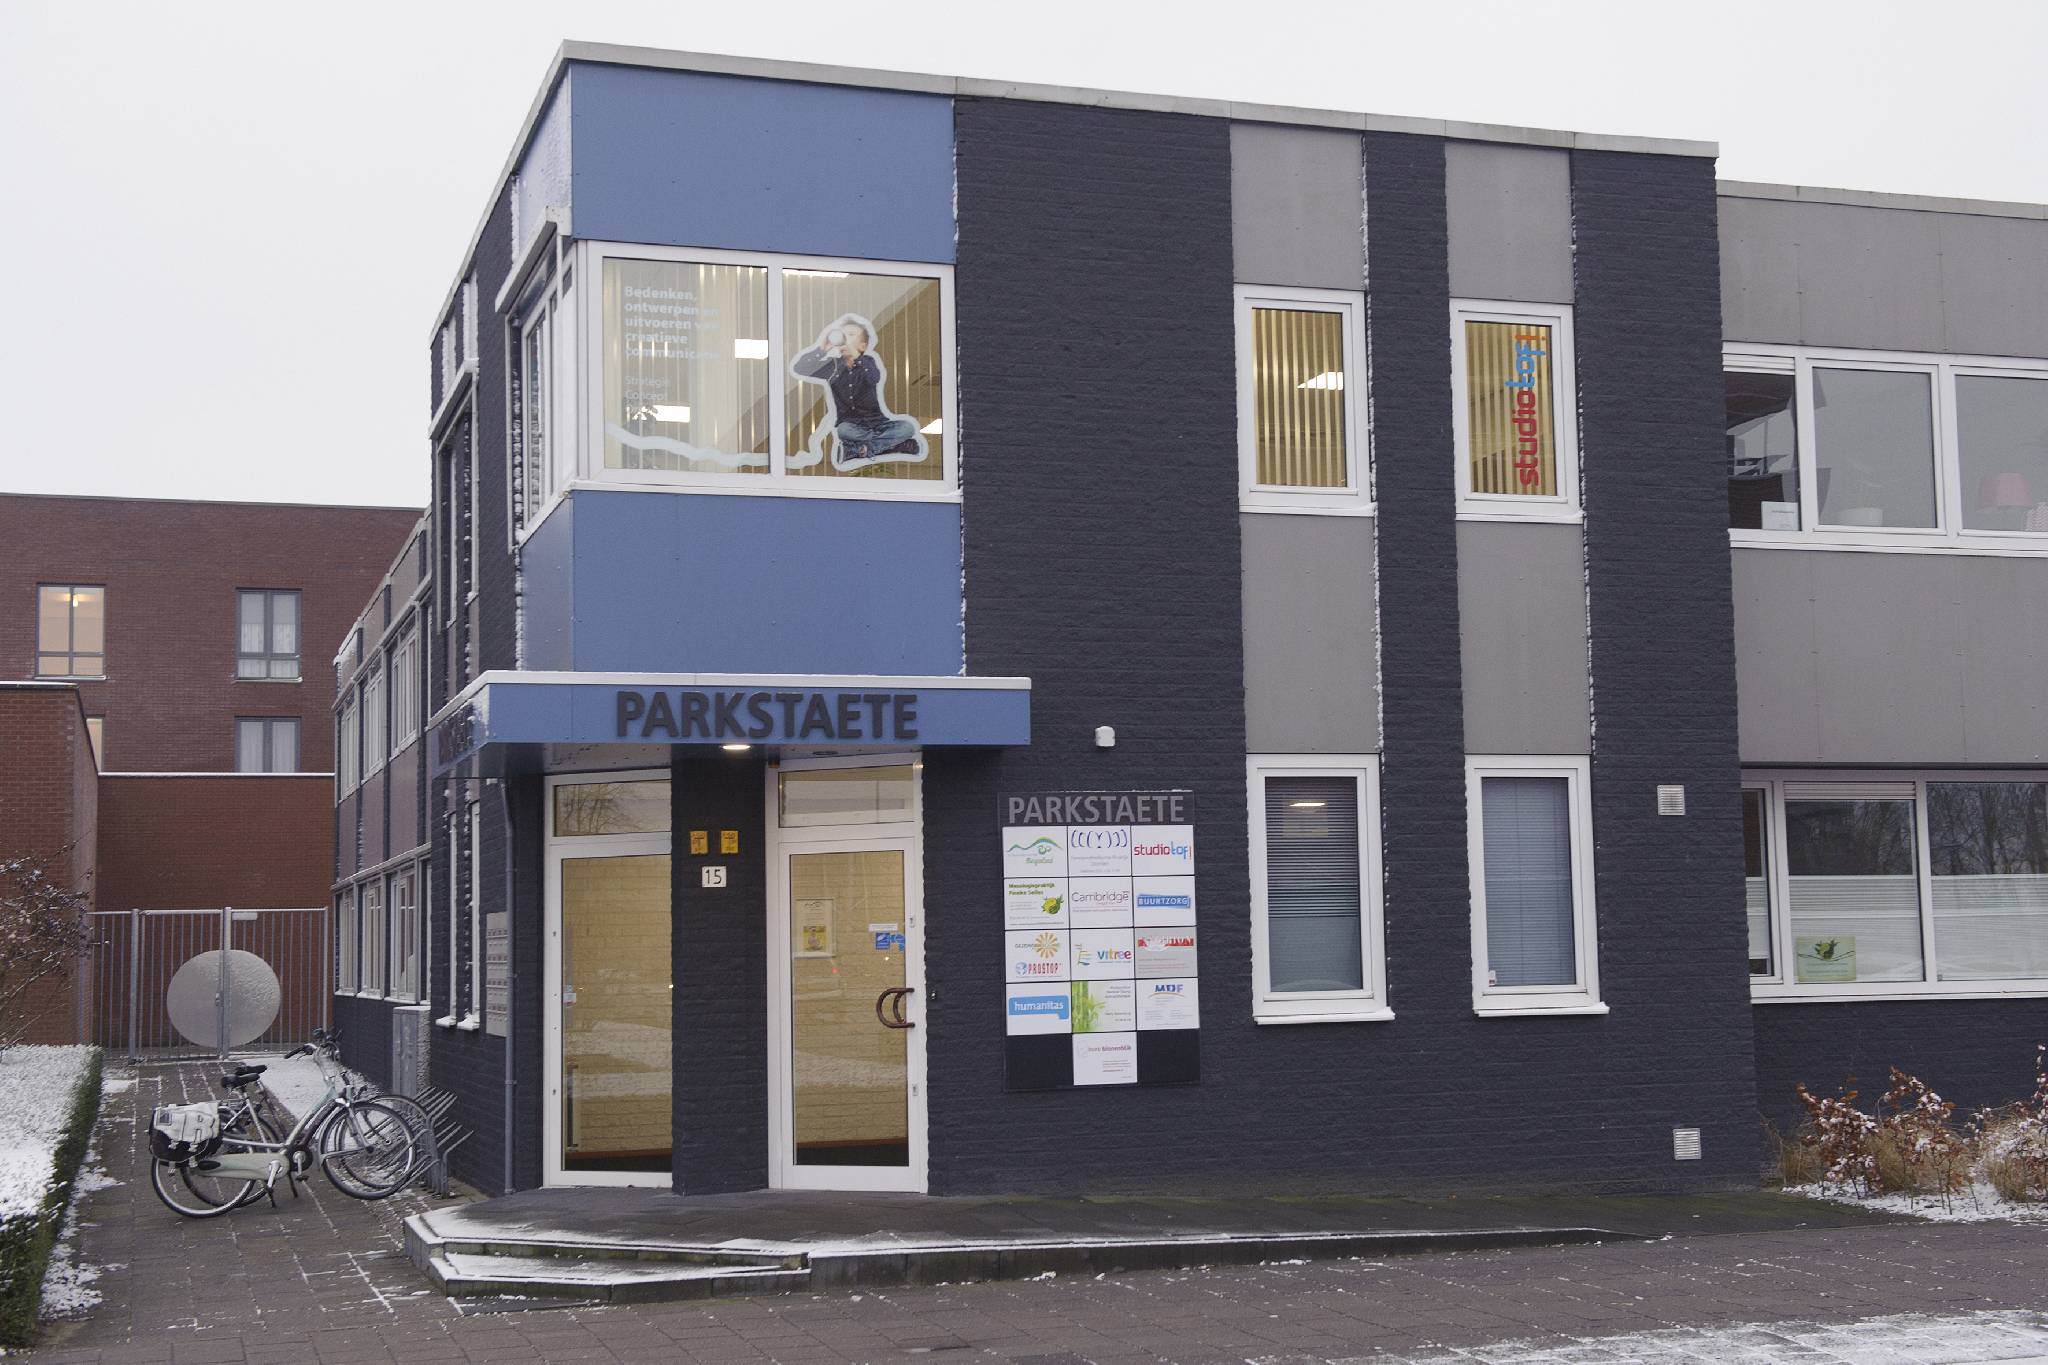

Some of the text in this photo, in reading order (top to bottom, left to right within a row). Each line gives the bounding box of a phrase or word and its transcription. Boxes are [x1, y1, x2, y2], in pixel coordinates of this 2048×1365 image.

[624, 286, 697, 301] Bedenken,
[624, 302, 698, 316] ontwerpen
[624, 315, 692, 329] uitvoeren
[616, 690, 919, 739] PARKSTAETE
[1008, 795, 1185, 824] PARKSTAETE
[705, 868, 722, 885] 15
[1071, 891, 1130, 904] Cambridge
[1138, 896, 1188, 905] BUURTZORG
[1097, 948, 1133, 960] vitree
[1014, 1000, 1064, 1011] humanitas
